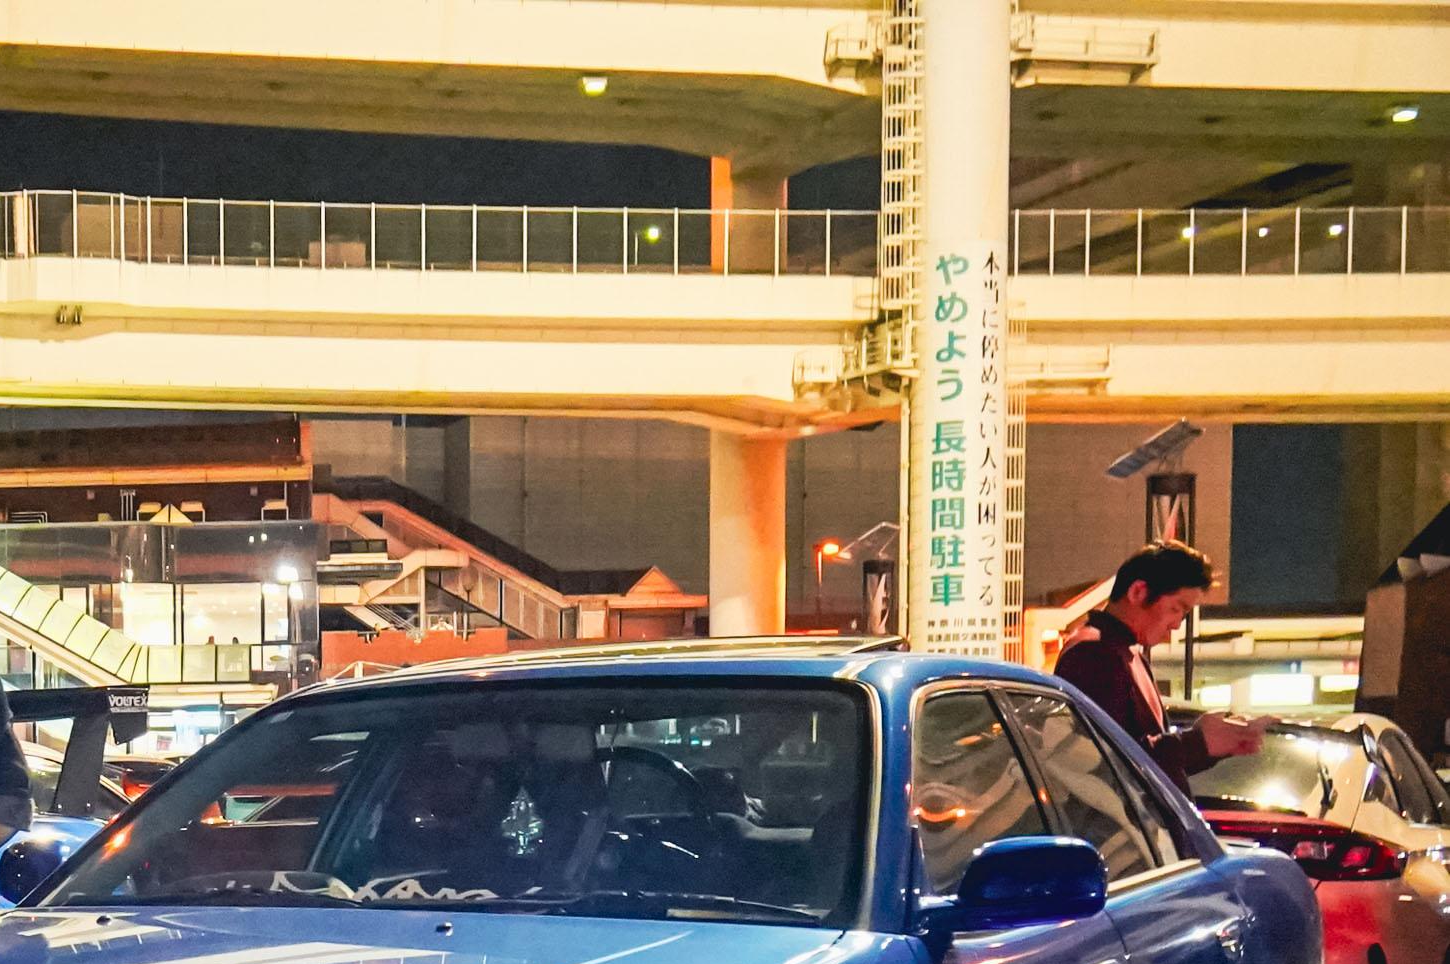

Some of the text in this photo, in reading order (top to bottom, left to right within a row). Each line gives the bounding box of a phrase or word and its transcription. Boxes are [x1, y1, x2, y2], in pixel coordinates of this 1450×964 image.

[935, 253, 969, 402] やめよう
[930, 419, 967, 607] 長時間駐車
[108, 693, 148, 707] VOLTEX
